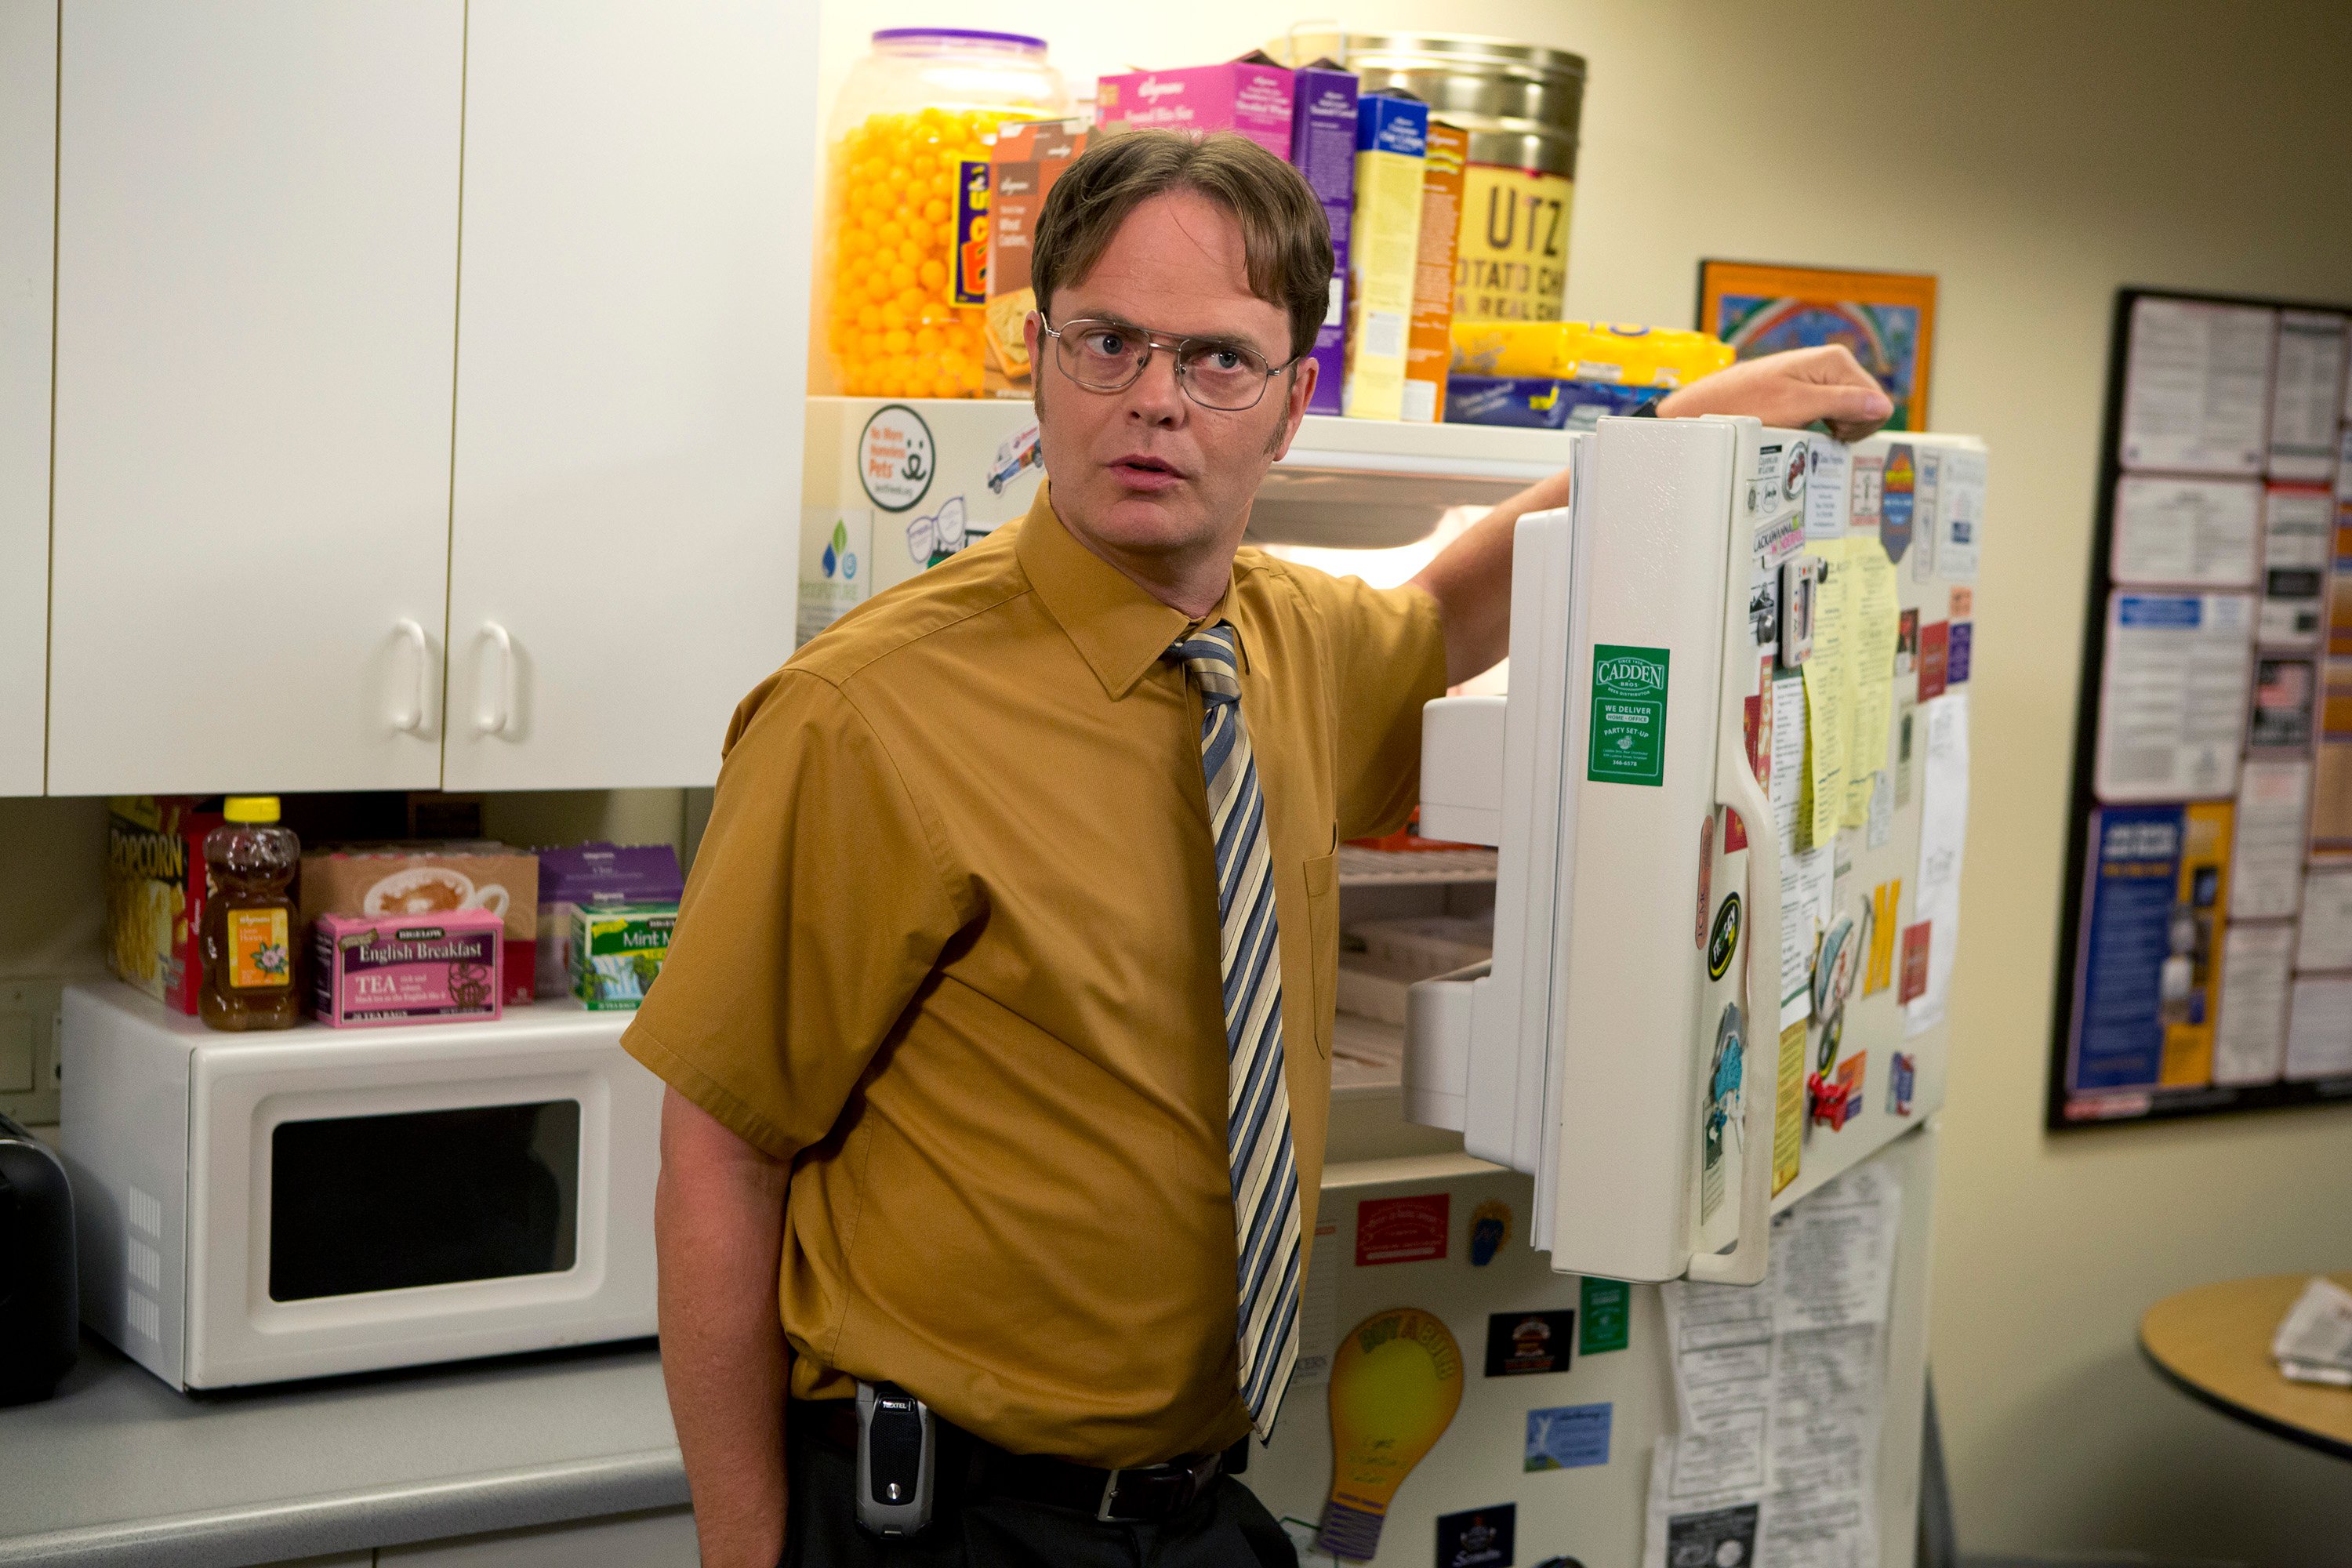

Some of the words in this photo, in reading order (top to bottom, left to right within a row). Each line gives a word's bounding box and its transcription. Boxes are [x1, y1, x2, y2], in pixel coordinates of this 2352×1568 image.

[1487, 185, 1562, 256] UTZ
[1599, 663, 1663, 688] CADDEN
[1618, 706, 1651, 714] DELIVER
[1603, 728, 1624, 736] PARTY
[1626, 728, 1650, 738] SET-UP
[110, 828, 183, 879] POPCORN
[398, 929, 442, 940] BIGELOW
[623, 930, 659, 947] Mint
[359, 942, 413, 965] English
[416, 941, 482, 960] Breakfast
[354, 975, 397, 994] TEA
